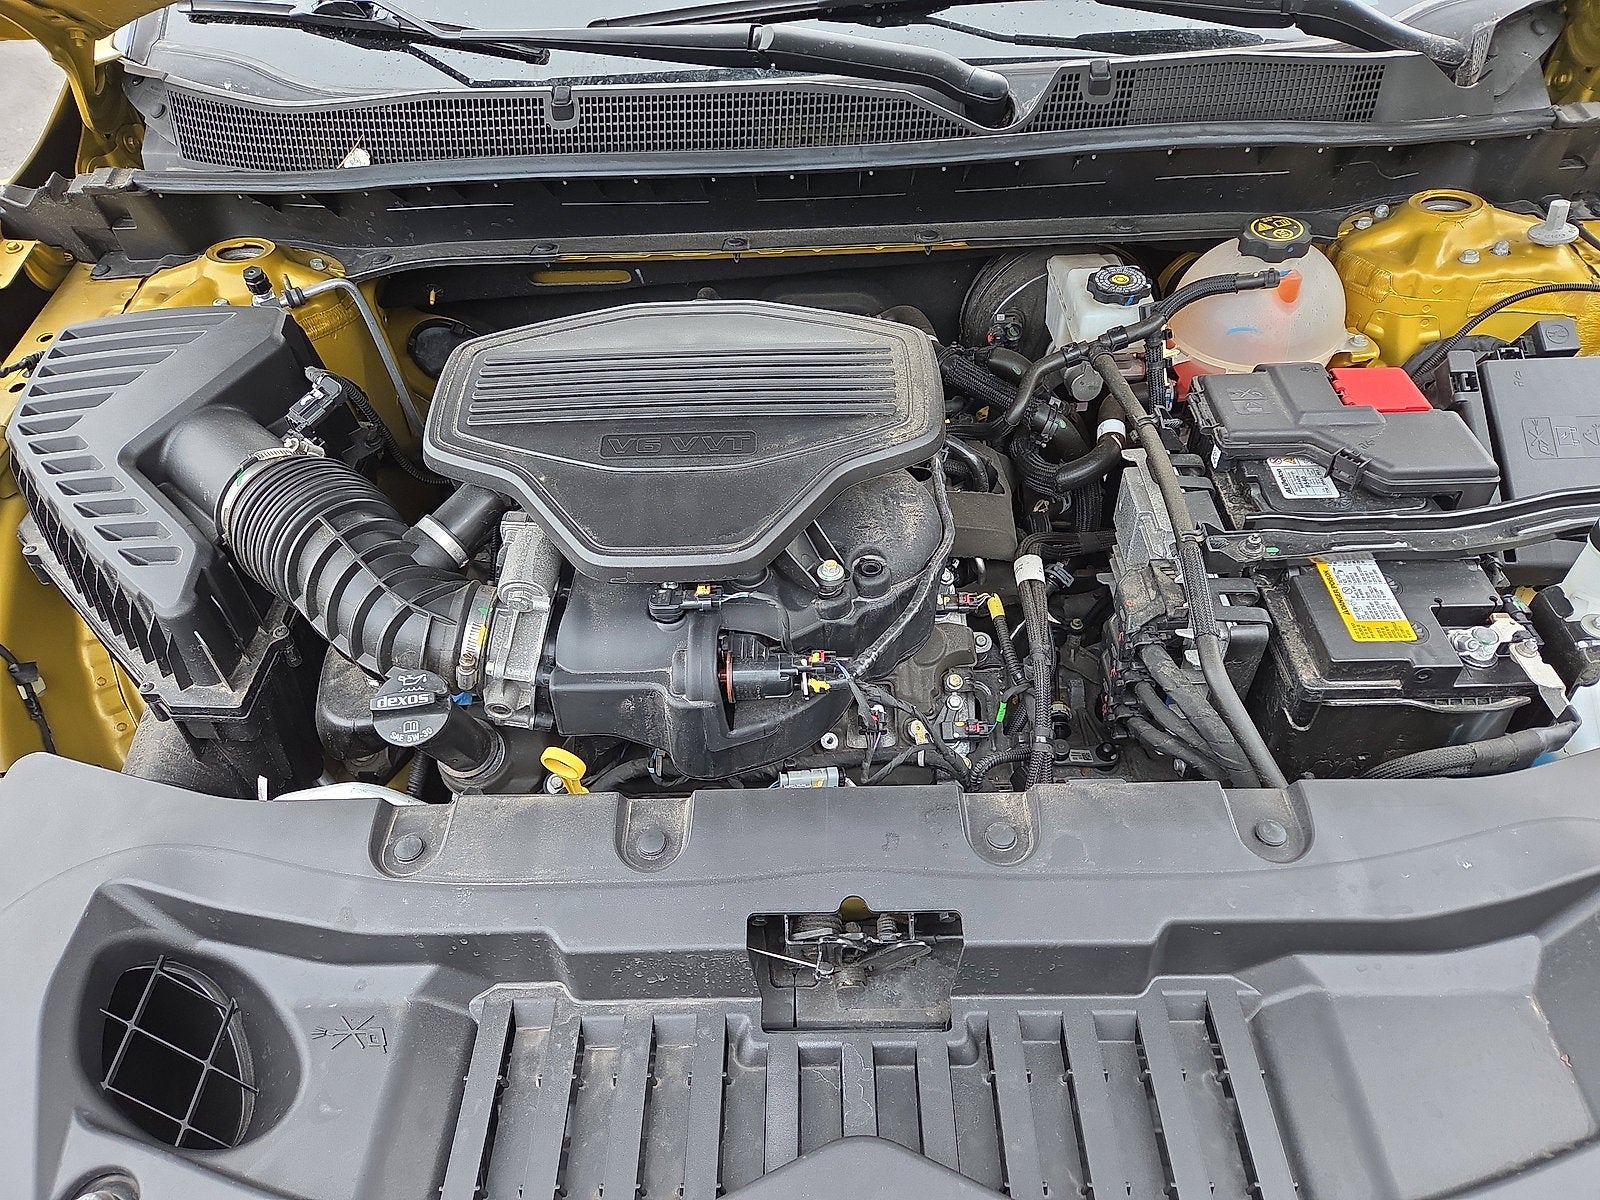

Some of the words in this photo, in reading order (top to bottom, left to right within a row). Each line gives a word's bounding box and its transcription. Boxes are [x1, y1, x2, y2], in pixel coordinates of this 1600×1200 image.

[608, 436, 663, 454] V6
[670, 434, 751, 452] VVT
[377, 694, 429, 708] dexos
[390, 731, 404, 742] SAE
[407, 727, 434, 743] 5W-30
